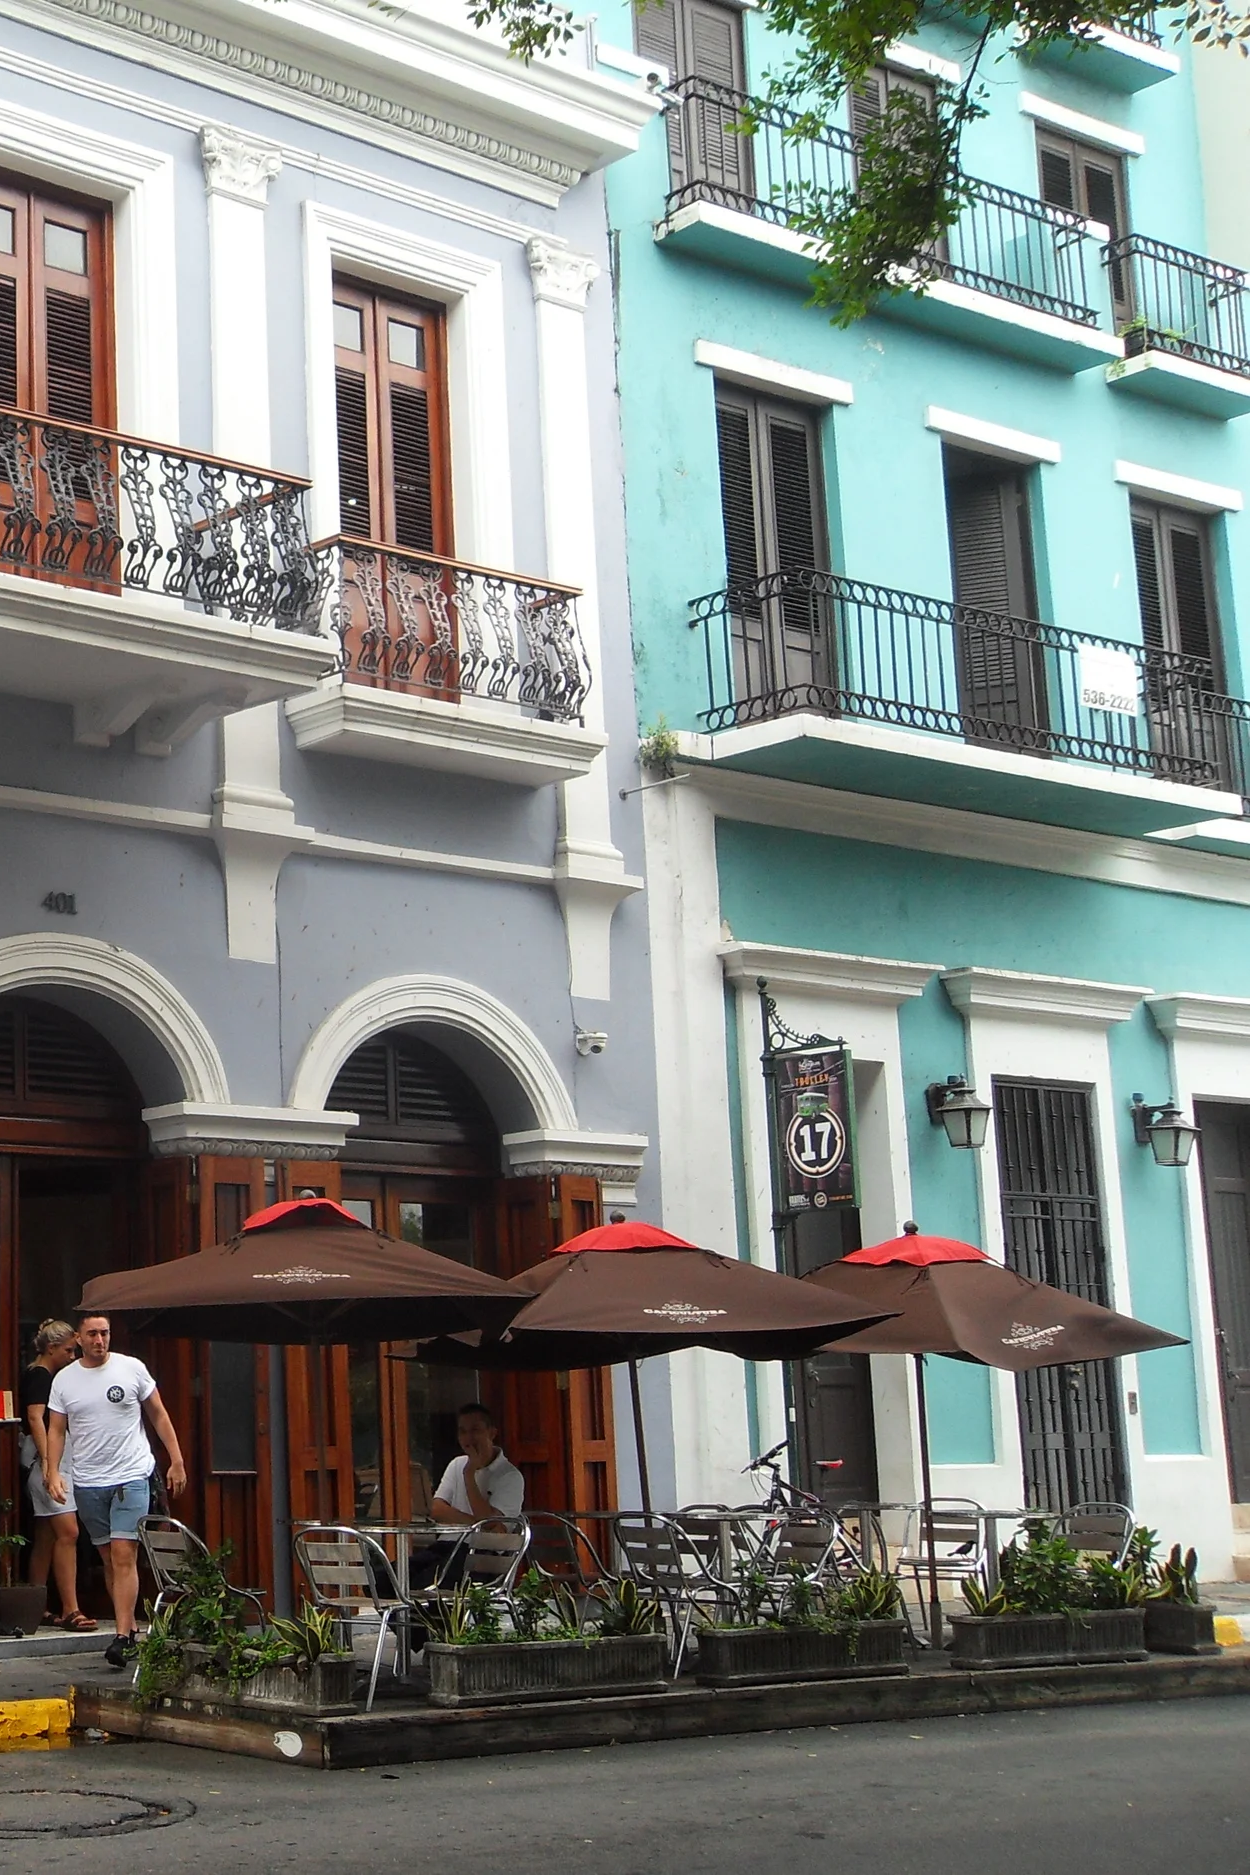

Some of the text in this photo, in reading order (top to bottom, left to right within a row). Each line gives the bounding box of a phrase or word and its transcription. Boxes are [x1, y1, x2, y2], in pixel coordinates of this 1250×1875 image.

[40, 890, 78, 916] 401
[795, 1073, 829, 1087] TROLLEY
[800, 1121, 832, 1162] 17
